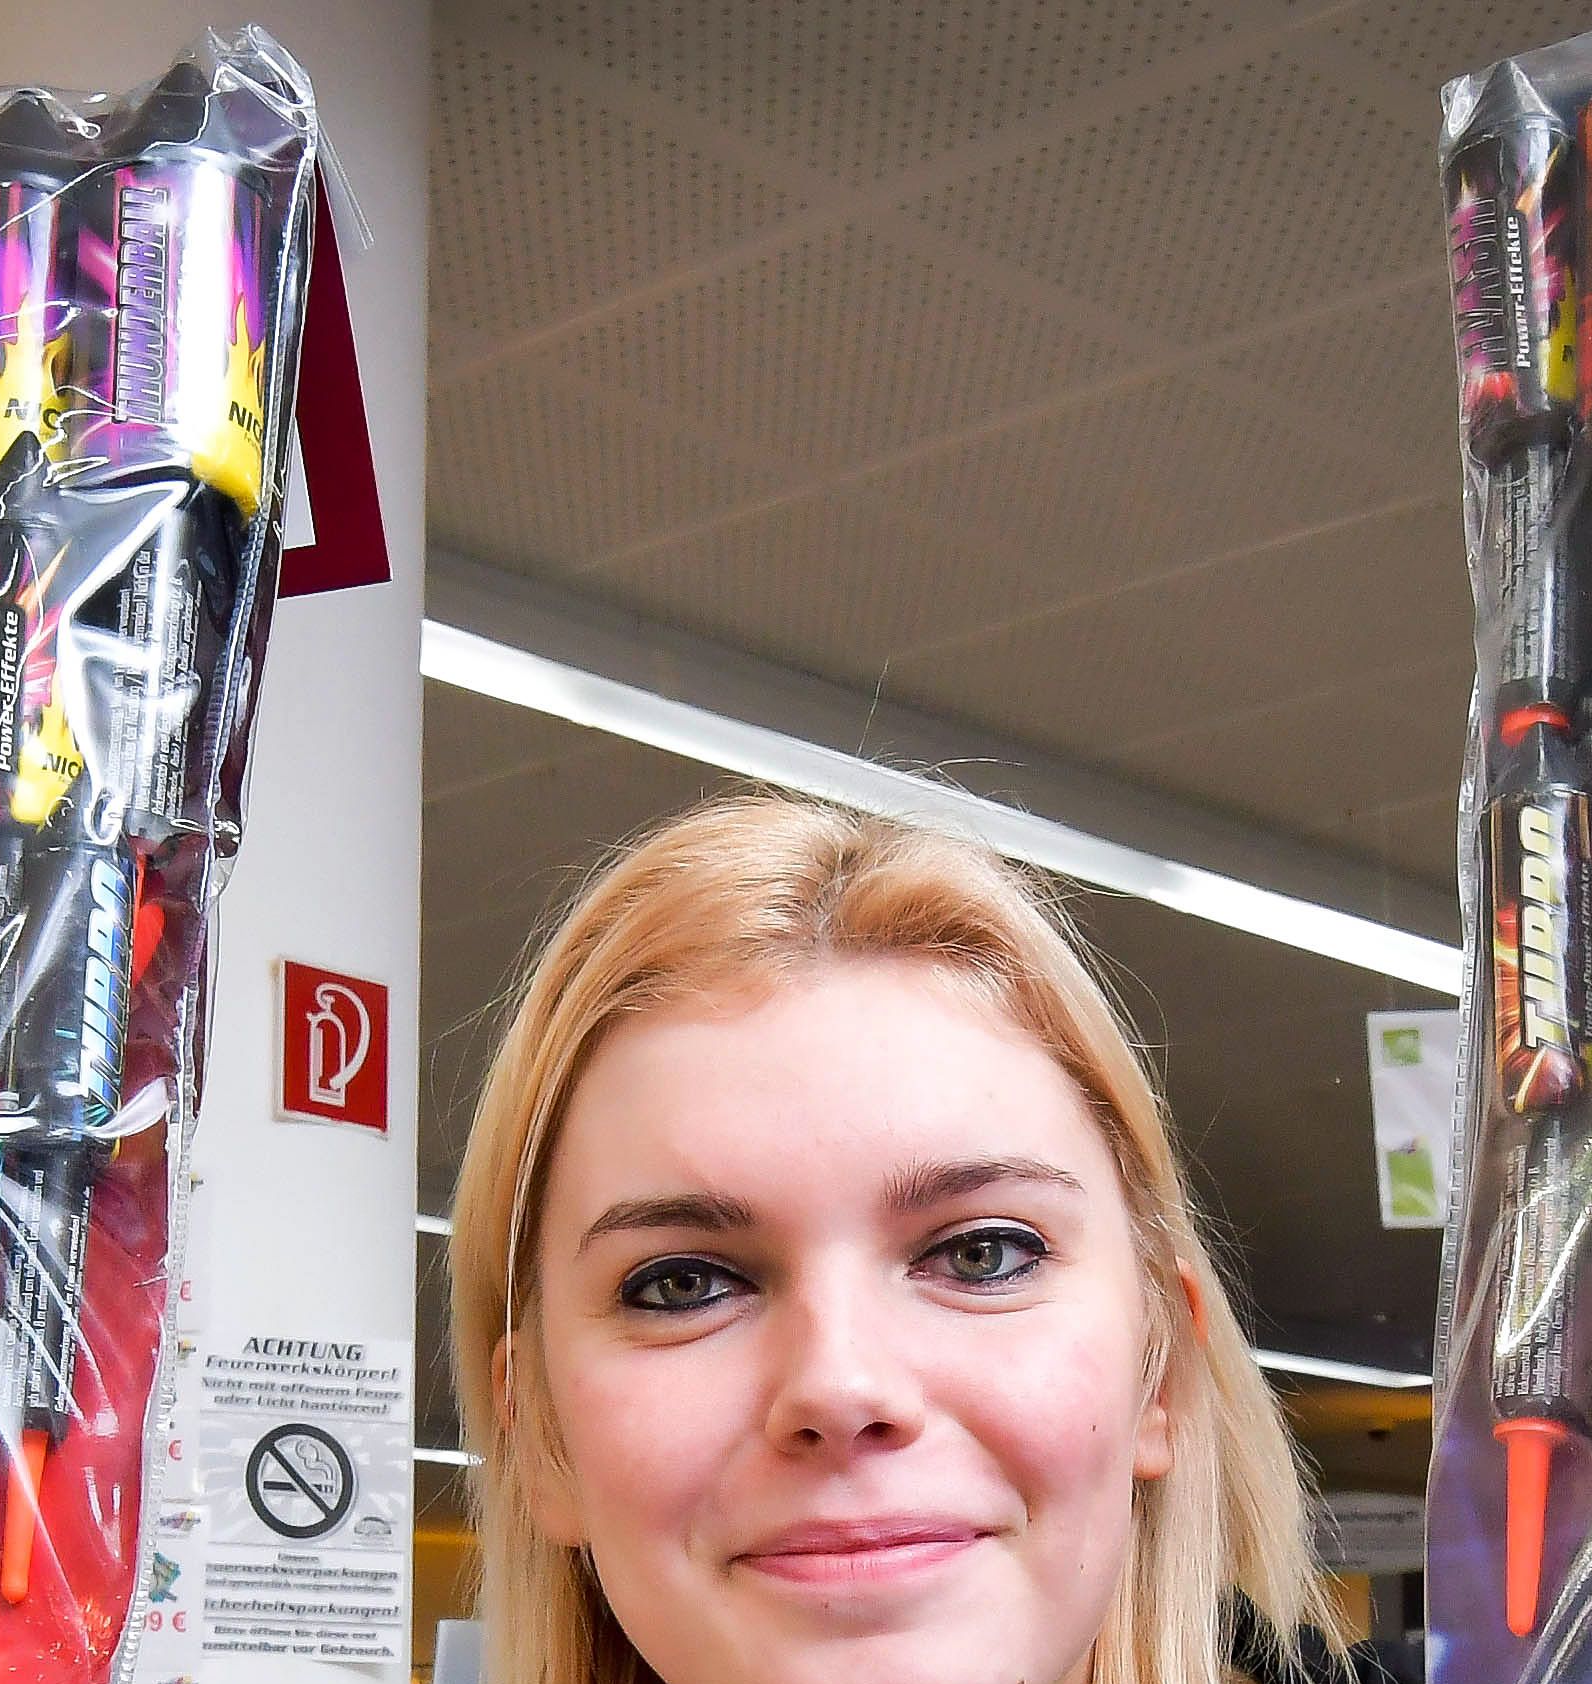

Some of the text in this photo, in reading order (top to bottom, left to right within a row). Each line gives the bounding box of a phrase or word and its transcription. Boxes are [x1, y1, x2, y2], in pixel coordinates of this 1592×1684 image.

[115, 185, 169, 424] THUNDERBALL
[1507, 215, 1531, 368] Power-Effekte
[205, 1355, 400, 1382] Feuerwerkskörper!
[243, 1336, 364, 1363] ACHTUNG
